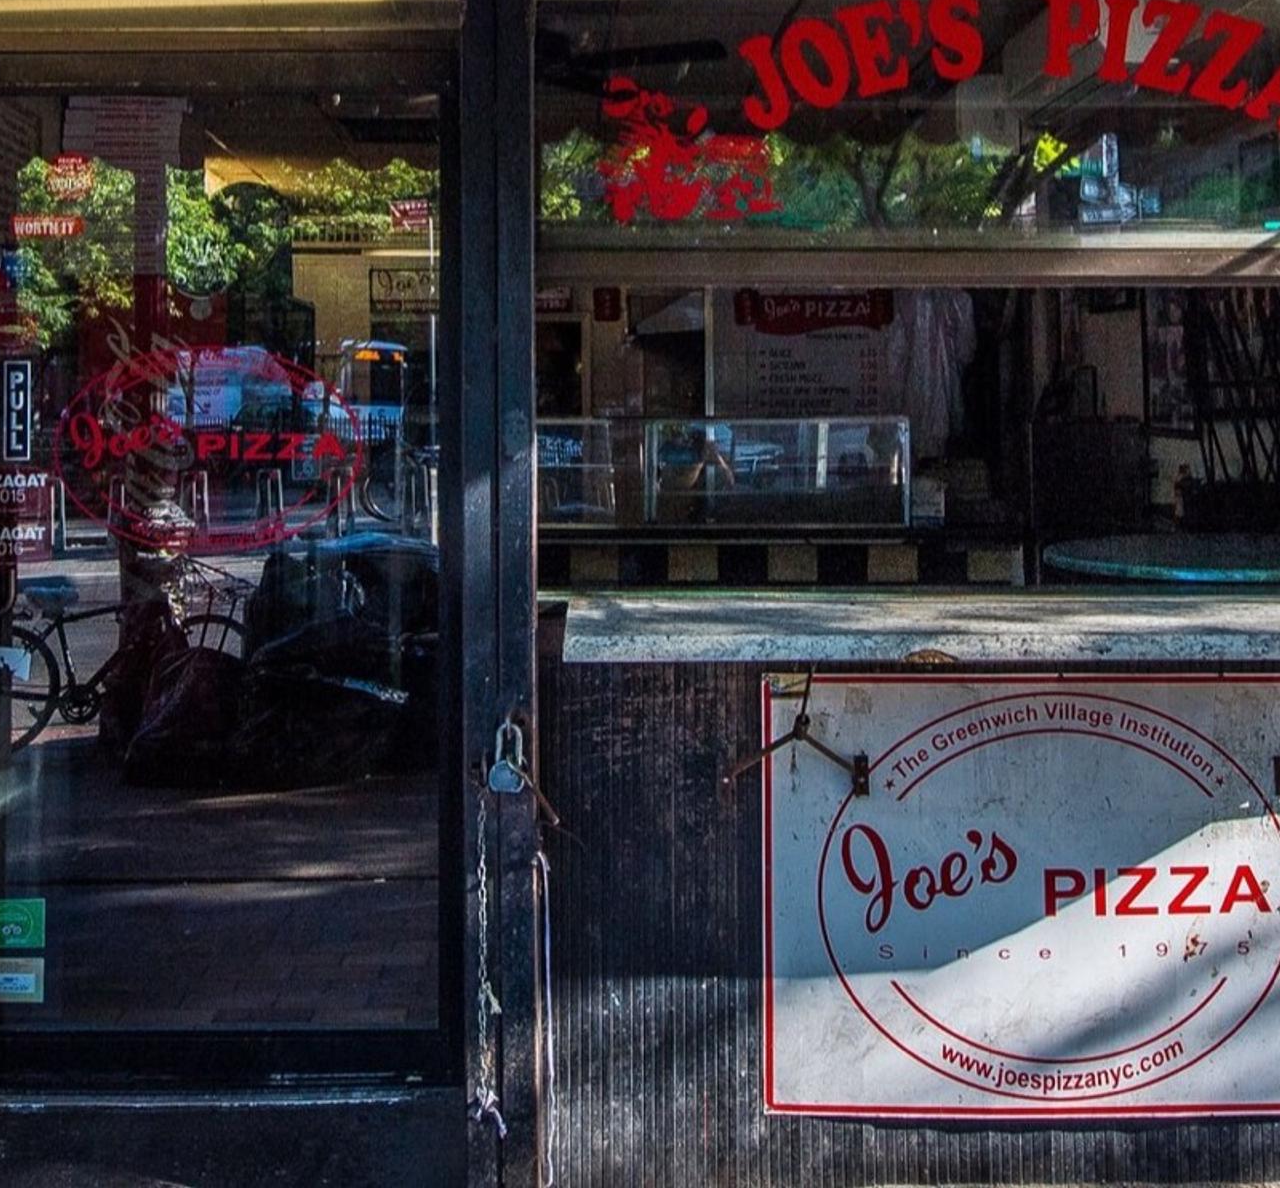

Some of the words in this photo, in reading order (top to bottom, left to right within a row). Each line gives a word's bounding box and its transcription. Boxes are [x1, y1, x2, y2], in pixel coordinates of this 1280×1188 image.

[804, 300, 868, 318] PIZZA
[9, 371, 24, 450] PULL
[68, 412, 184, 469] Joe's
[195, 431, 347, 461] PIZZA
[892, 747, 929, 778] The
[931, 704, 1038, 752] Greenwich
[1044, 702, 1113, 728] Village
[1120, 713, 1214, 777] Institution
[841, 824, 1018, 933] Joe's
[1044, 865, 1271, 916] PIZZA
[878, 943, 1053, 959] Since
[941, 1040, 1184, 1093] www.joespizzanyc.com
